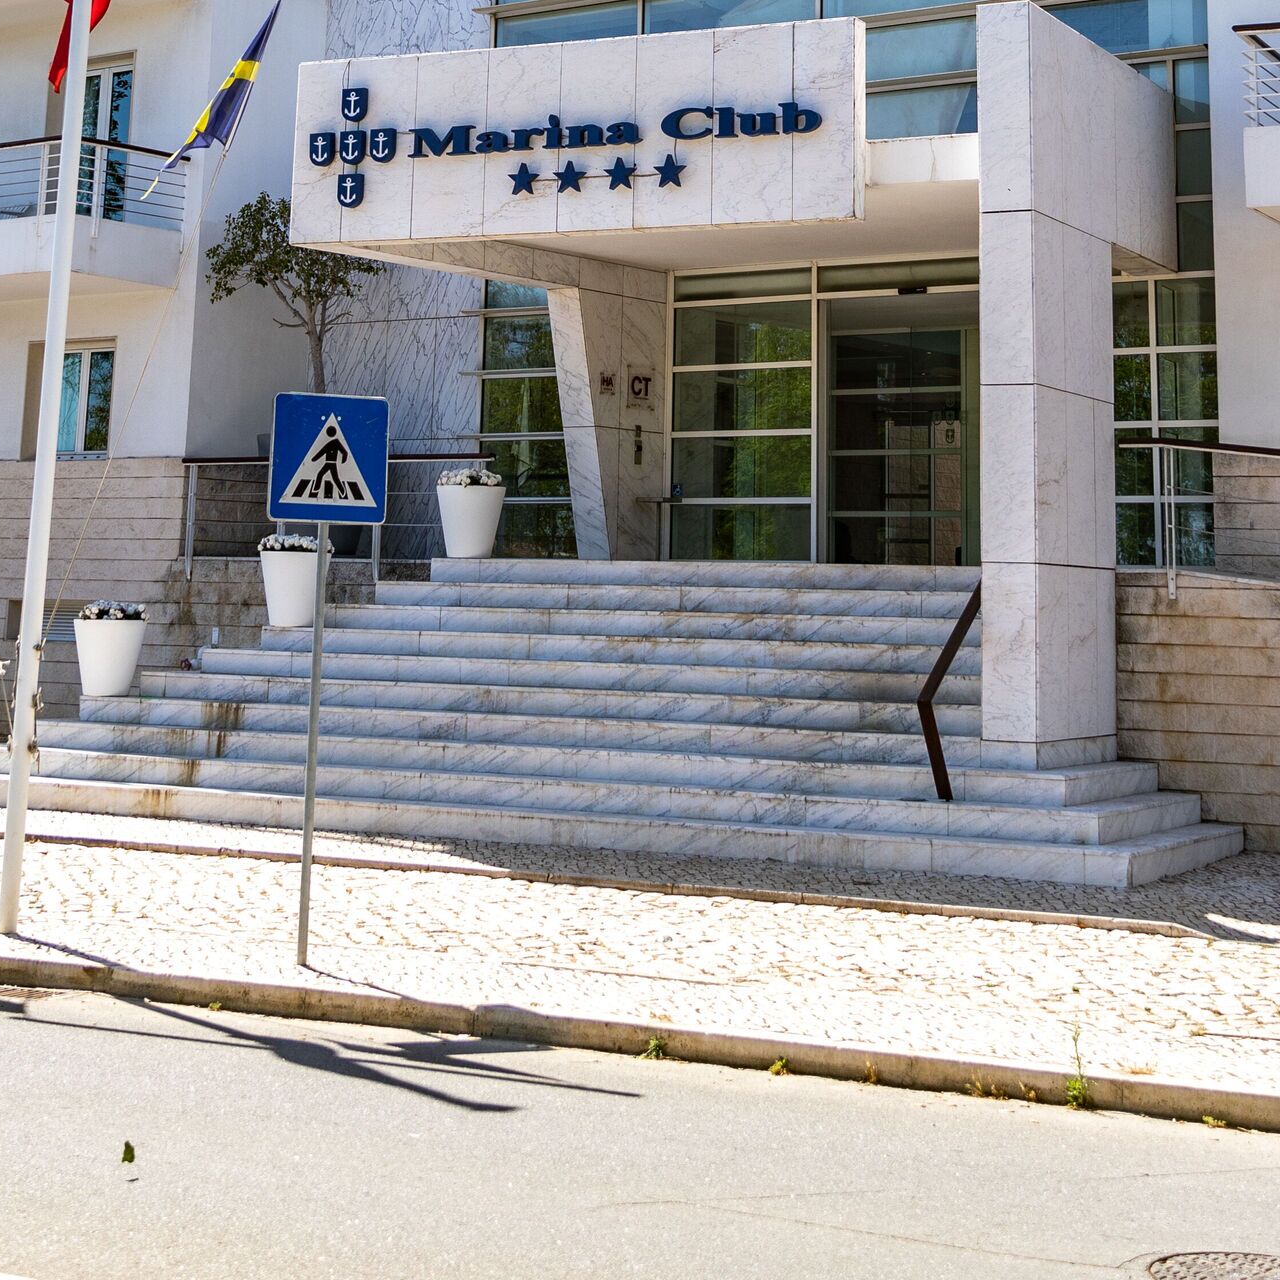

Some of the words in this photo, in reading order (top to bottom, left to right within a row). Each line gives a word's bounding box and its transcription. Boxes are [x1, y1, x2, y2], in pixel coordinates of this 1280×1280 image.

[408, 114, 644, 159] Marina
[660, 101, 823, 141] Club
[631, 376, 652, 396] CT
